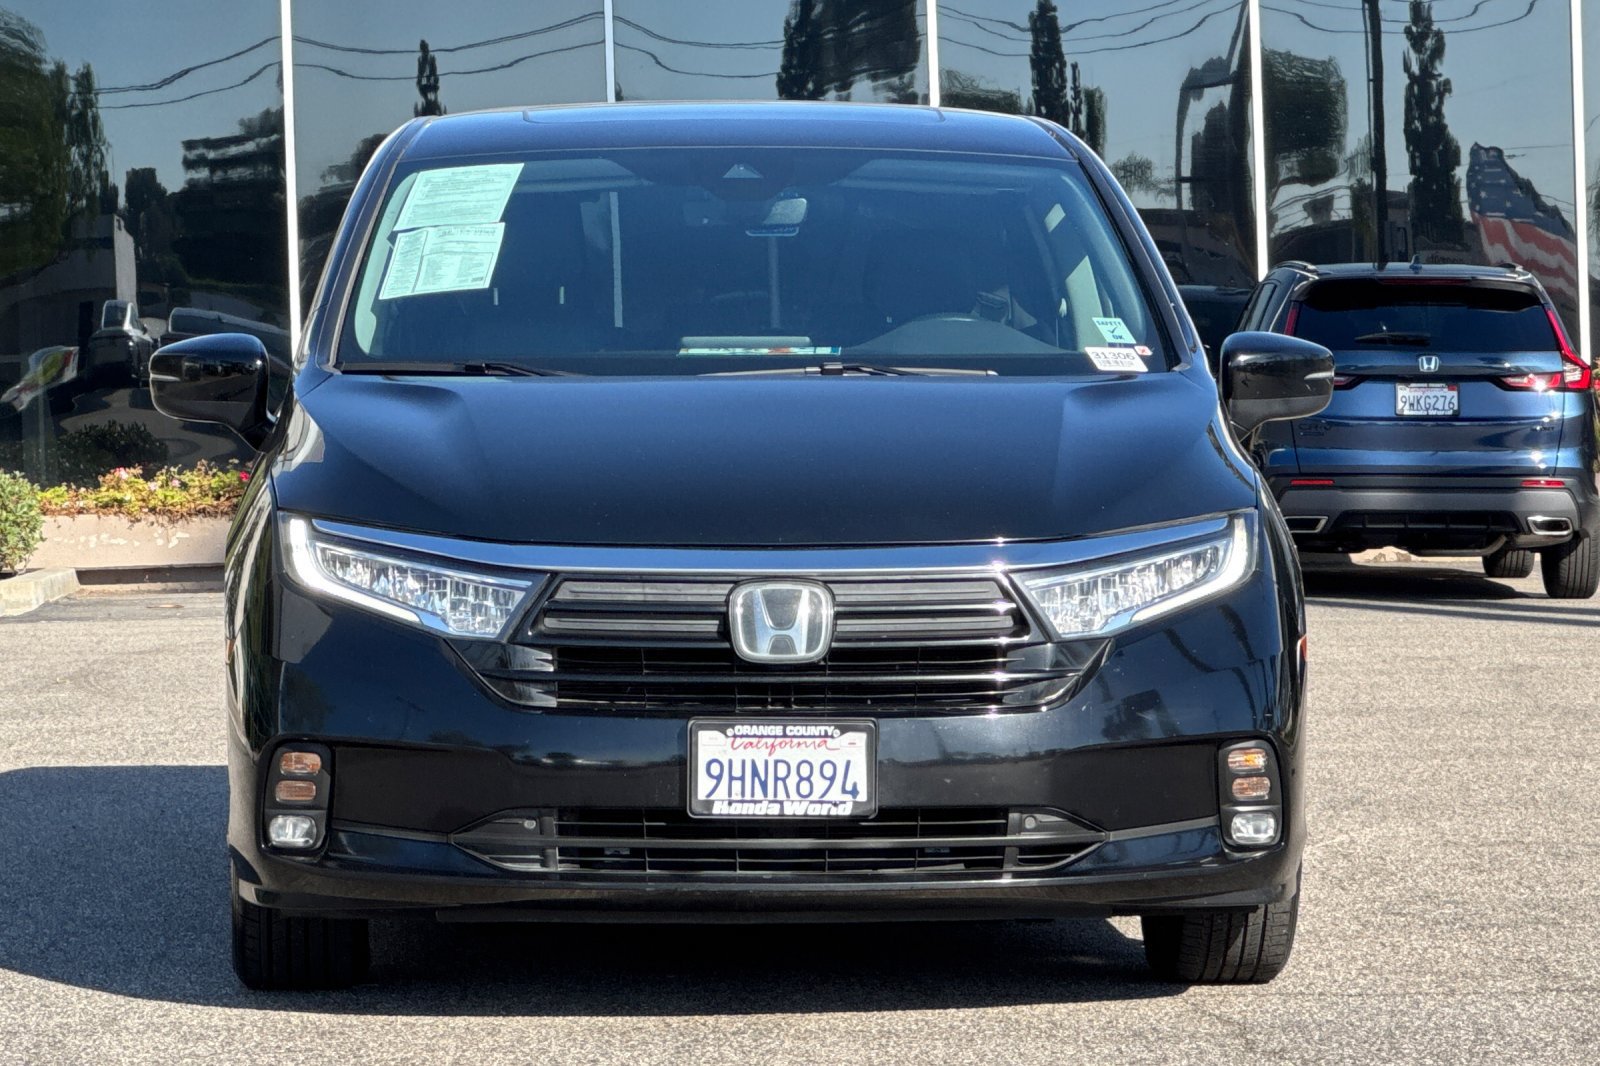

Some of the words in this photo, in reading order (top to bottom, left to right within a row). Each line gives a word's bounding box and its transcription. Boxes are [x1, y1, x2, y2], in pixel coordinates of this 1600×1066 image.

[1091, 351, 1136, 361] 31306
[1400, 395, 1455, 410] 9WKG276
[734, 725, 782, 737] ORANGE
[785, 725, 834, 737] COUNTY
[730, 736, 840, 757] California
[705, 758, 860, 799] 9HNR894
[711, 800, 781, 816] Honda
[783, 800, 853, 816] World
